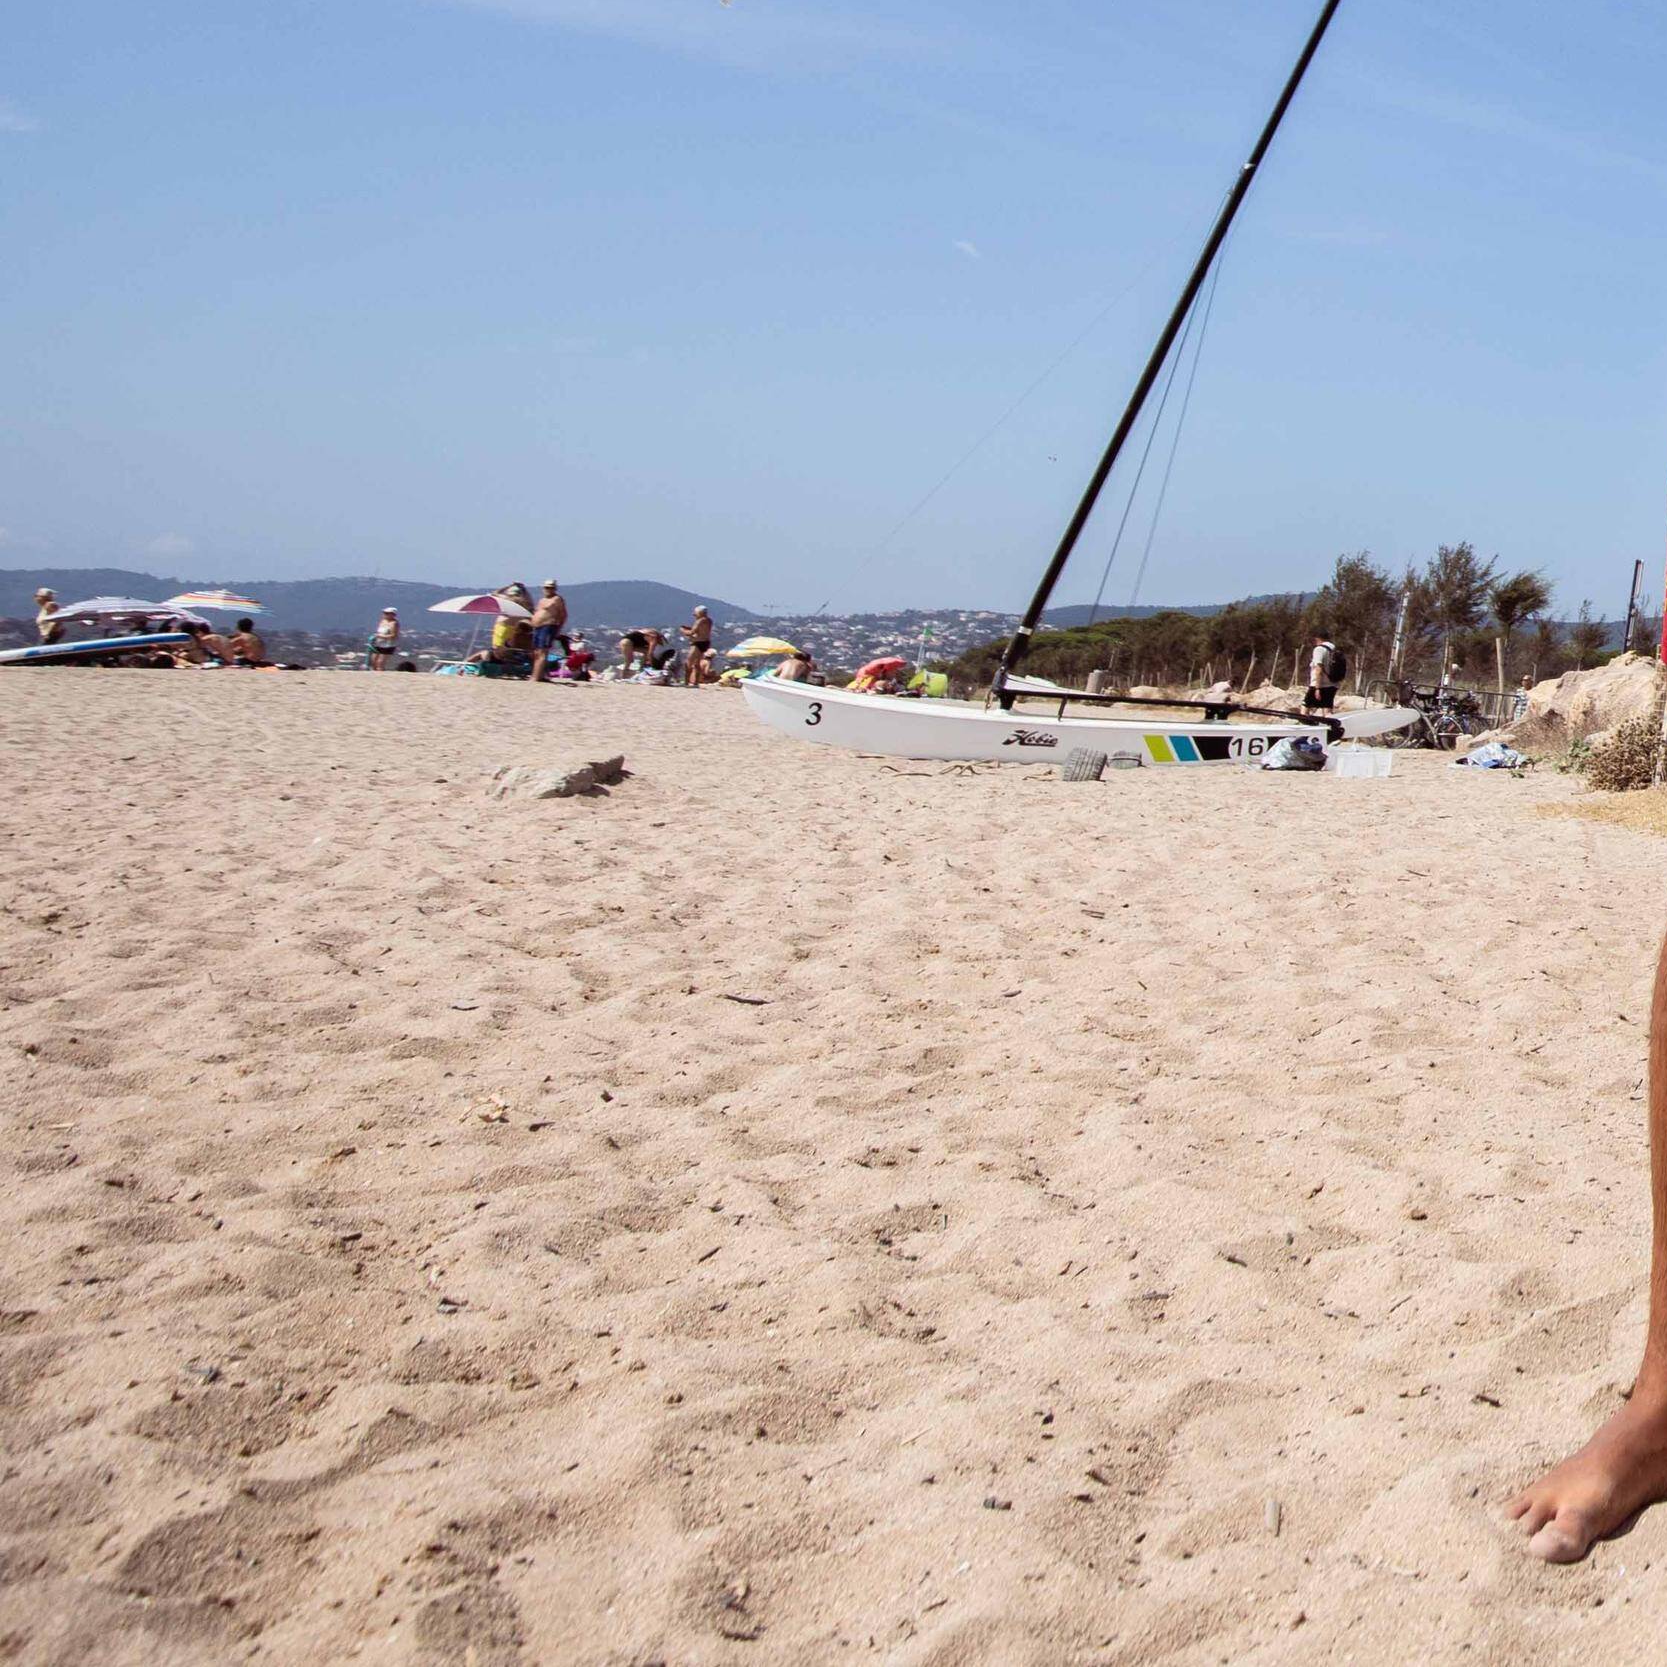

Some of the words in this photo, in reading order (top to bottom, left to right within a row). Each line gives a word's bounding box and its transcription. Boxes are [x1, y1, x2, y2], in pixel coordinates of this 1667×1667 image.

[805, 702, 823, 726] 3
[1002, 729, 1059, 748] Hobie
[1231, 737, 1265, 757] 16
